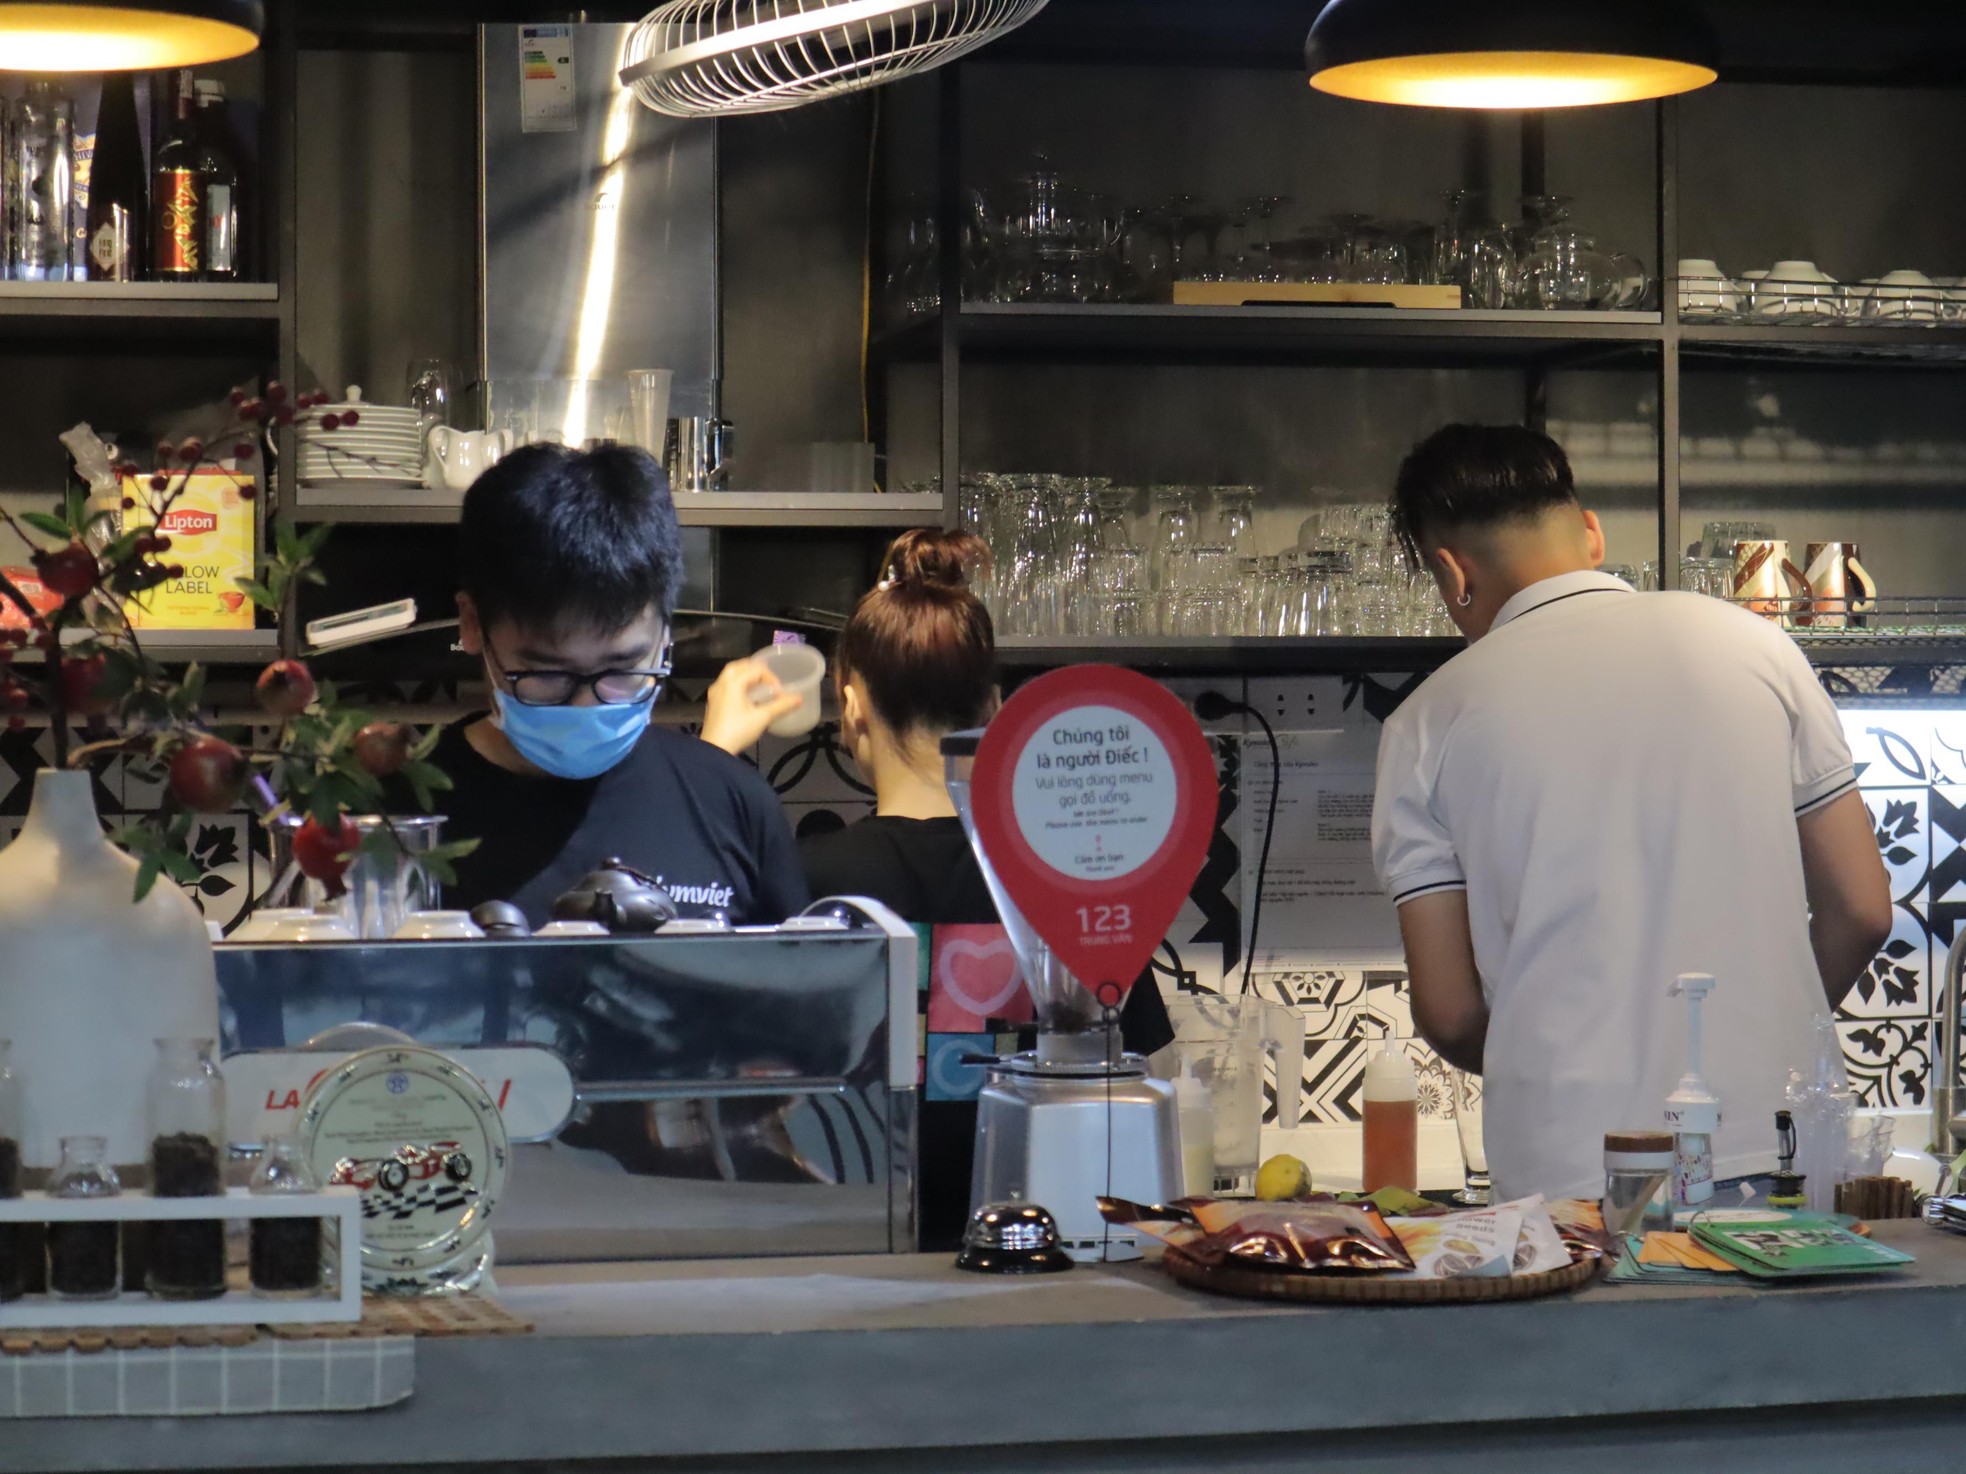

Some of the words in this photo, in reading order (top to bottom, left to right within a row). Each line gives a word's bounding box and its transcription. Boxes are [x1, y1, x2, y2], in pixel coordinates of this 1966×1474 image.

[165, 514, 213, 531] Lipton
[166, 581, 213, 594] LABEL
[1053, 728, 1103, 746] Chúng
[1109, 725, 1129, 741] tôi
[1037, 753, 1050, 768] là
[1056, 750, 1100, 771] người
[1105, 745, 1139, 765] Điếc
[1034, 777, 1054, 789] Vui
[1057, 776, 1084, 790] lòng
[1086, 774, 1116, 787] dùng
[1119, 772, 1153, 783] menu
[1059, 794, 1077, 809] gọi
[1081, 790, 1095, 805] đồ
[662, 880, 734, 907] mviet
[1076, 904, 1132, 933] 123
[265, 1089, 300, 1111] LA
